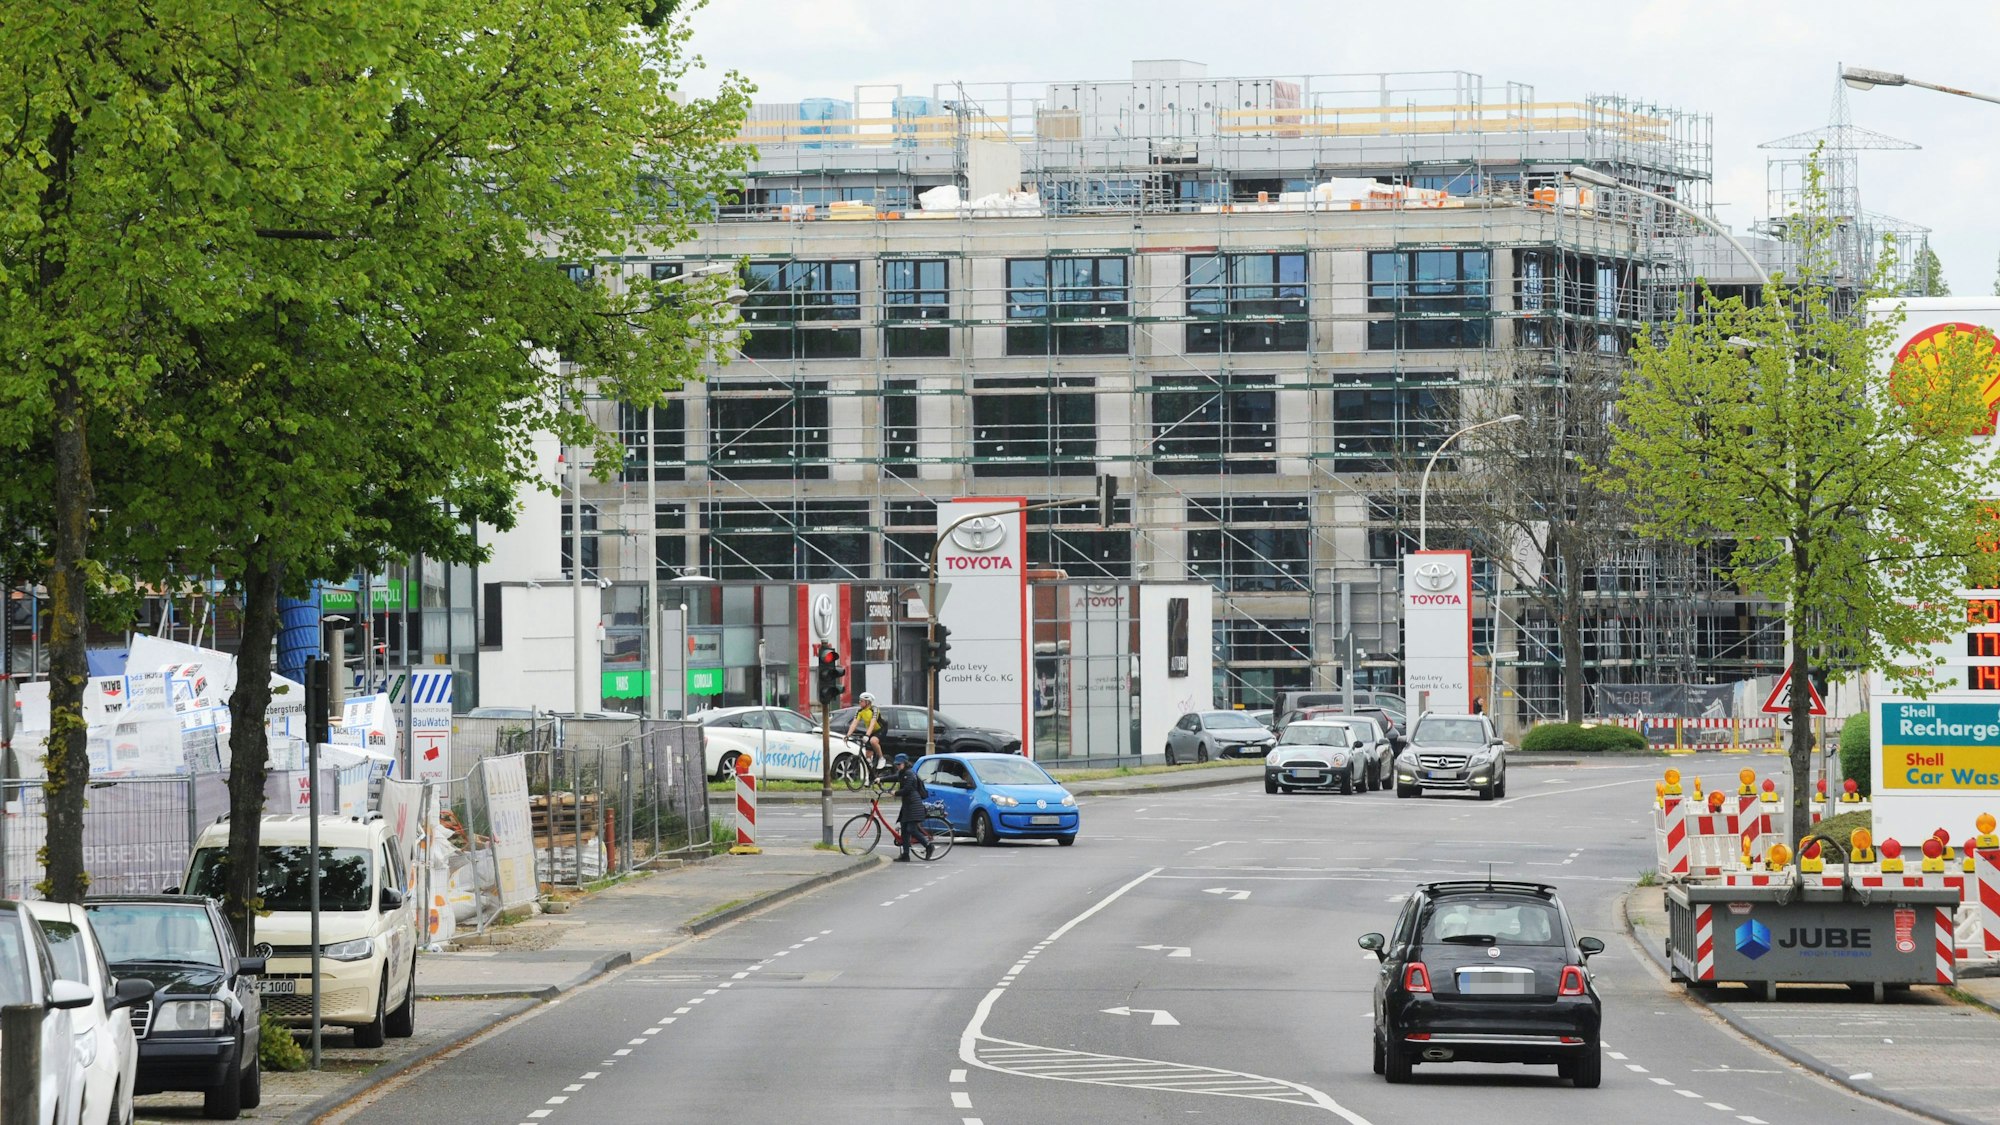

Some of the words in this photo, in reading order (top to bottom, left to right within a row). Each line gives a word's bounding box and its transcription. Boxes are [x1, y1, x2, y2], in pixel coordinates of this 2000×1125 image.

[946, 556, 1012, 570] TOYOTA
[325, 592, 352, 602] CROSS
[1410, 595, 1461, 605] TOYOTA
[1968, 600, 1999, 623] 20
[1976, 633, 1999, 656] 17
[946, 663, 965, 671] Auto
[968, 663, 988, 672] Levy
[616, 676, 629, 691] YARIS
[694, 674, 712, 688] COROLLA
[944, 674, 972, 682] GmbH
[975, 674, 982, 682] &
[984, 674, 999, 682] Co.
[1001, 674, 1014, 682] KG
[1428, 674, 1442, 683] Levy
[1976, 666, 1999, 690] 14
[1607, 690, 1654, 705] NEOBEL
[266, 704, 306, 716] zbergstraße
[1900, 705, 1935, 718] Shell
[412, 717, 450, 728] BauWatch
[1900, 718, 2000, 741] Recharge
[755, 746, 822, 772] Wasserstoff
[1906, 753, 1944, 766] Shell
[1906, 768, 1944, 784] Car
[1951, 768, 1999, 785] Was
[1779, 928, 1872, 948] JUBE
[269, 982, 293, 992] 1000
